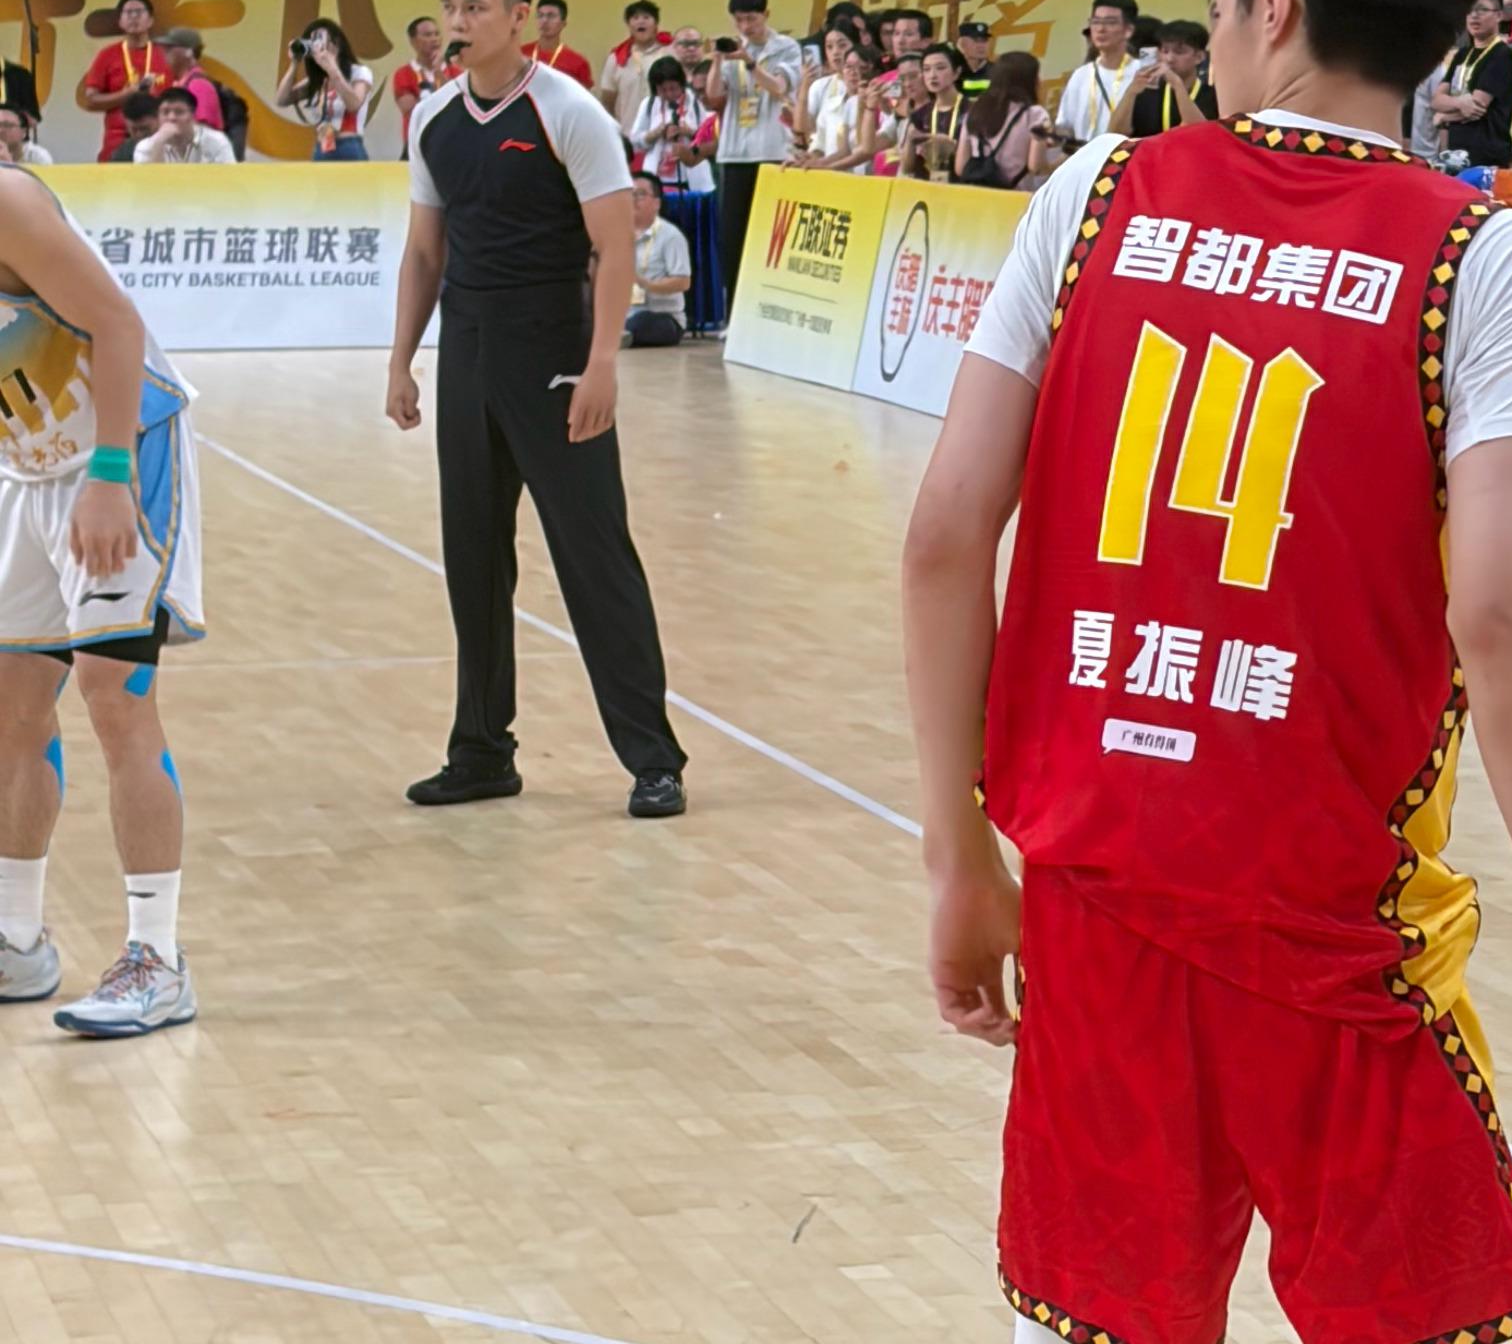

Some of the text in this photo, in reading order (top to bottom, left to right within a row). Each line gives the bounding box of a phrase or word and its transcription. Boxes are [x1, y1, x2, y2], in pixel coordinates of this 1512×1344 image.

[86, 226, 381, 266] 省城市篮球联赛
[790, 202, 852, 261] 万联证券
[1112, 214, 1404, 325] 智都集团
[142, 272, 183, 288] CITY
[188, 271, 304, 288] BASKETBALL
[310, 270, 381, 287] LEAGUE
[1097, 320, 1326, 592] 14
[1069, 609, 1298, 721] 夏振峰
